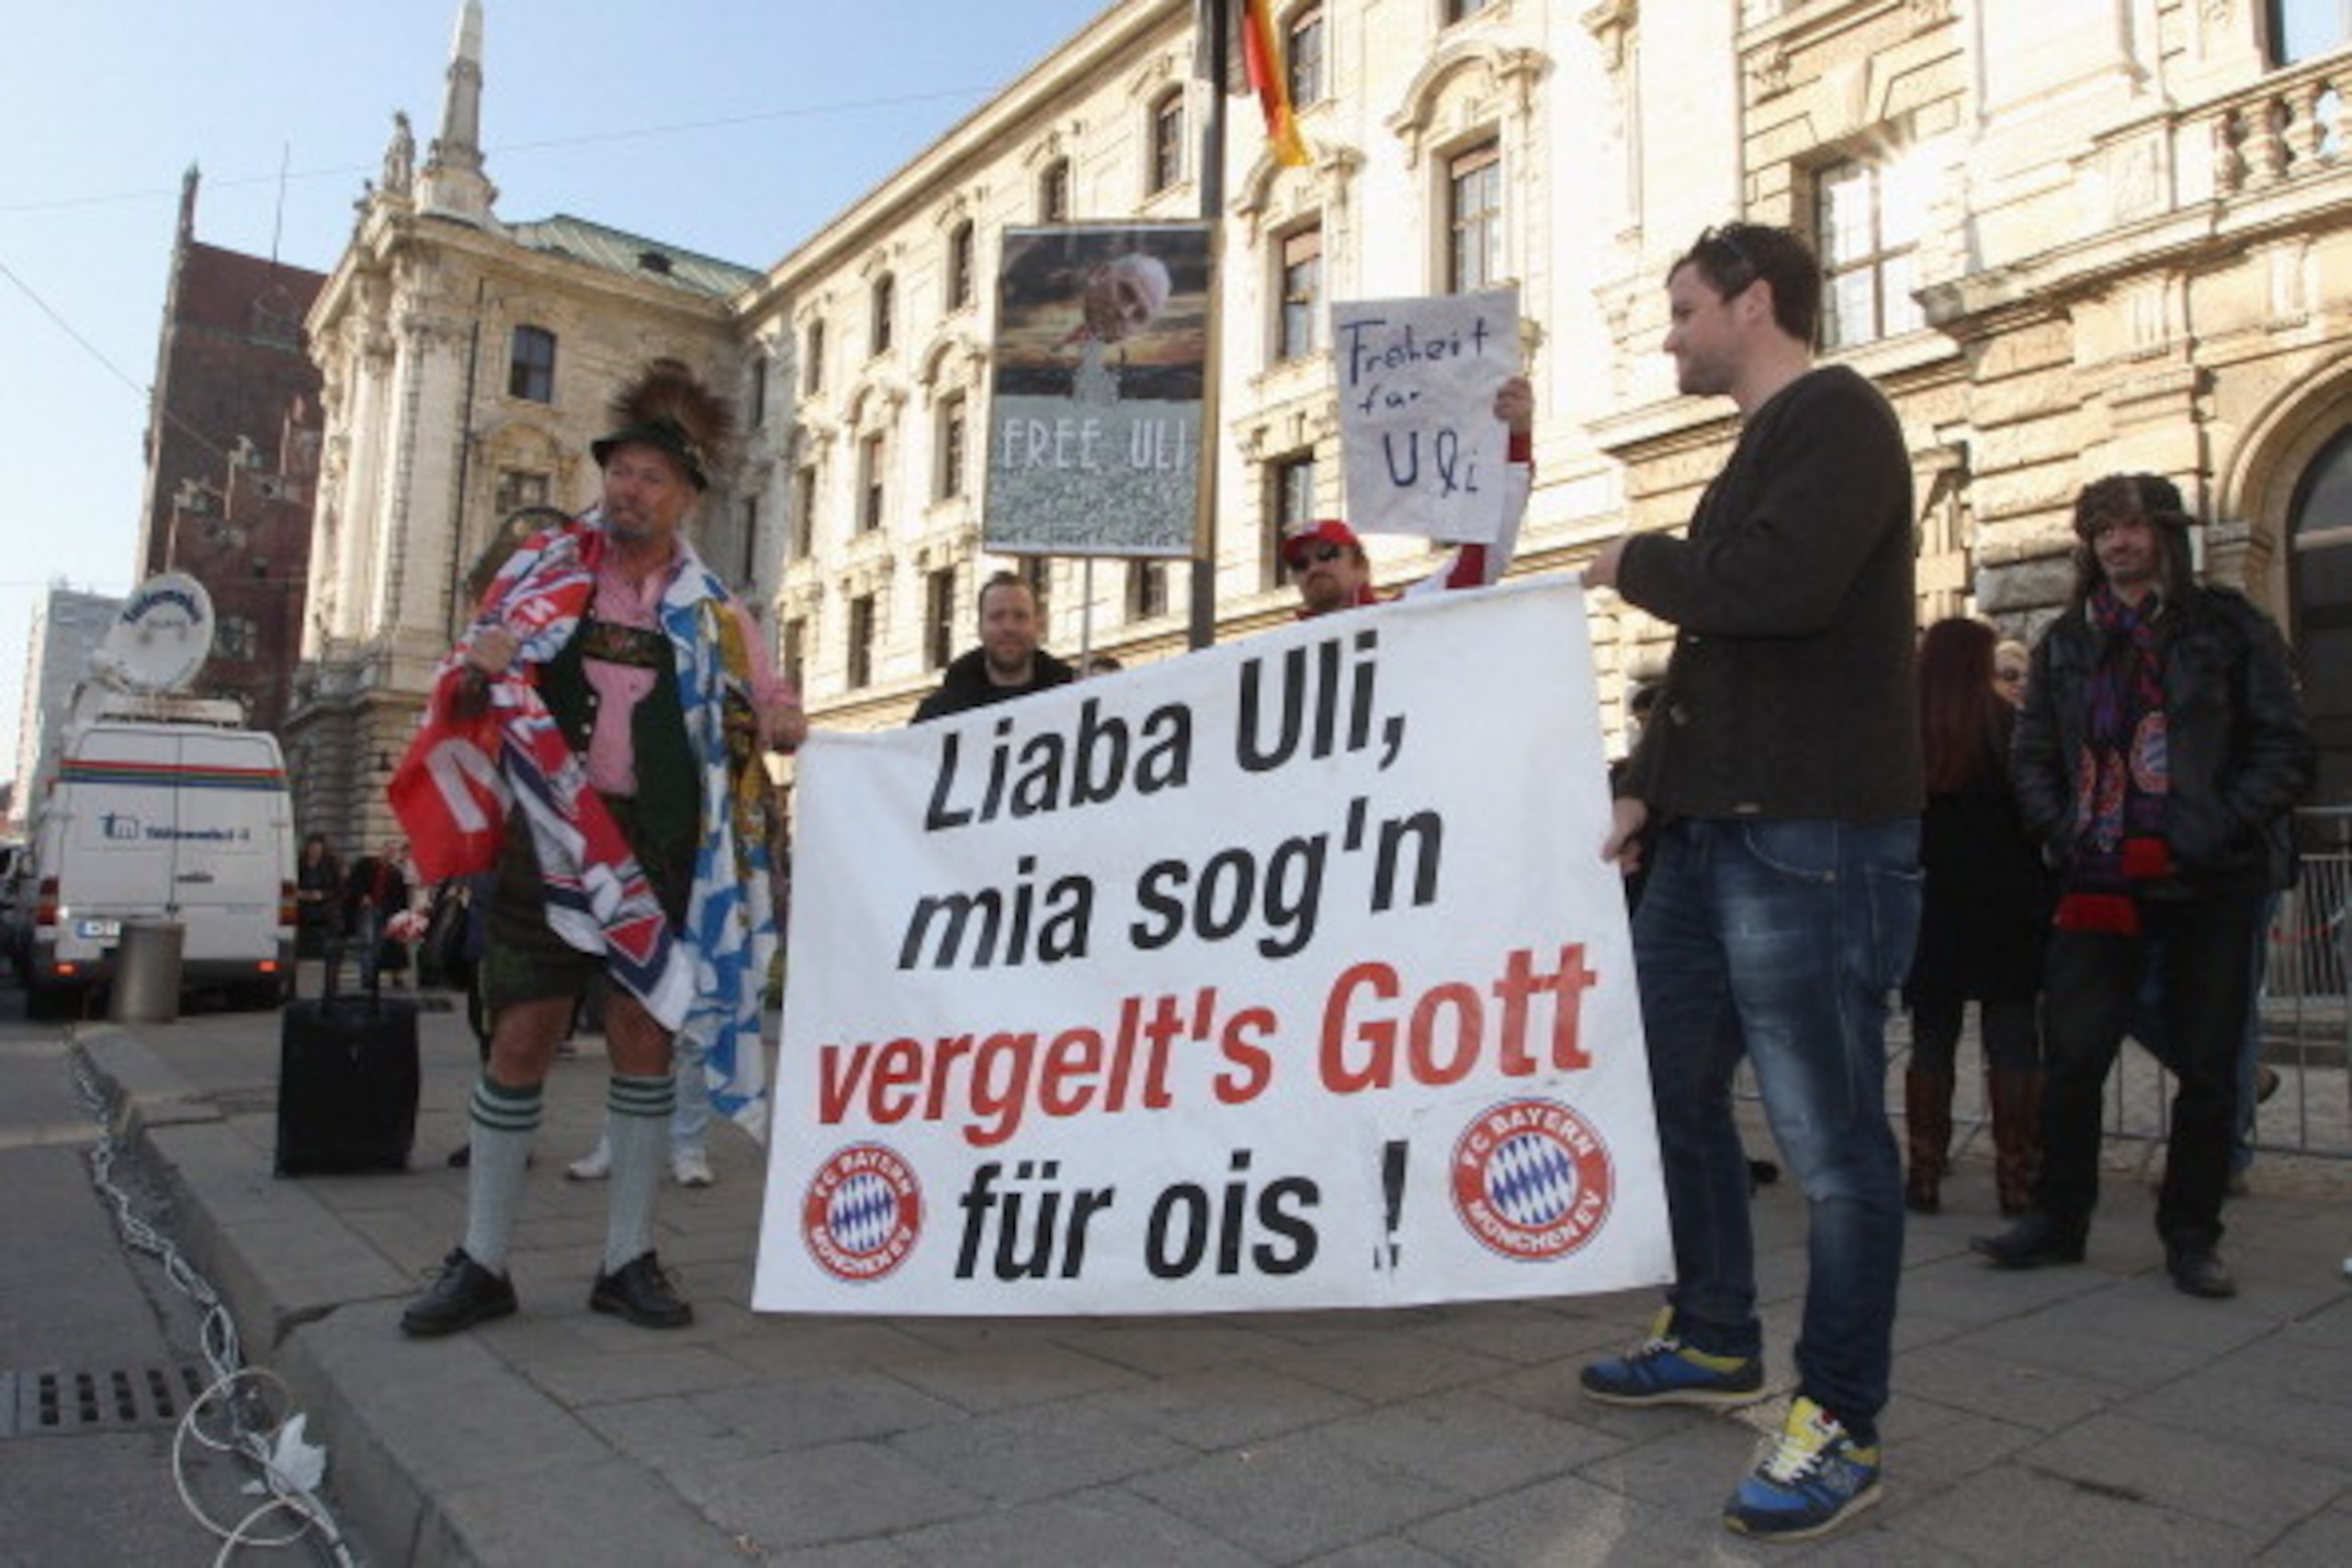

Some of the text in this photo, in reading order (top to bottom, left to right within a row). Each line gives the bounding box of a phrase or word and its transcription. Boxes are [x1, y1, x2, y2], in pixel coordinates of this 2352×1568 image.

[1001, 418, 1187, 470] FREE ULI
[1383, 428, 1480, 500] Uli
[924, 629, 1405, 832] Liaba Uli,
[898, 796, 1442, 970] mia sog'n
[820, 943, 1597, 1147] vergelt's Gott
[838, 1150, 912, 1196] BAYERN
[1461, 1107, 1597, 1169] FC BAYERN
[954, 1140, 1409, 1282] für ois !
